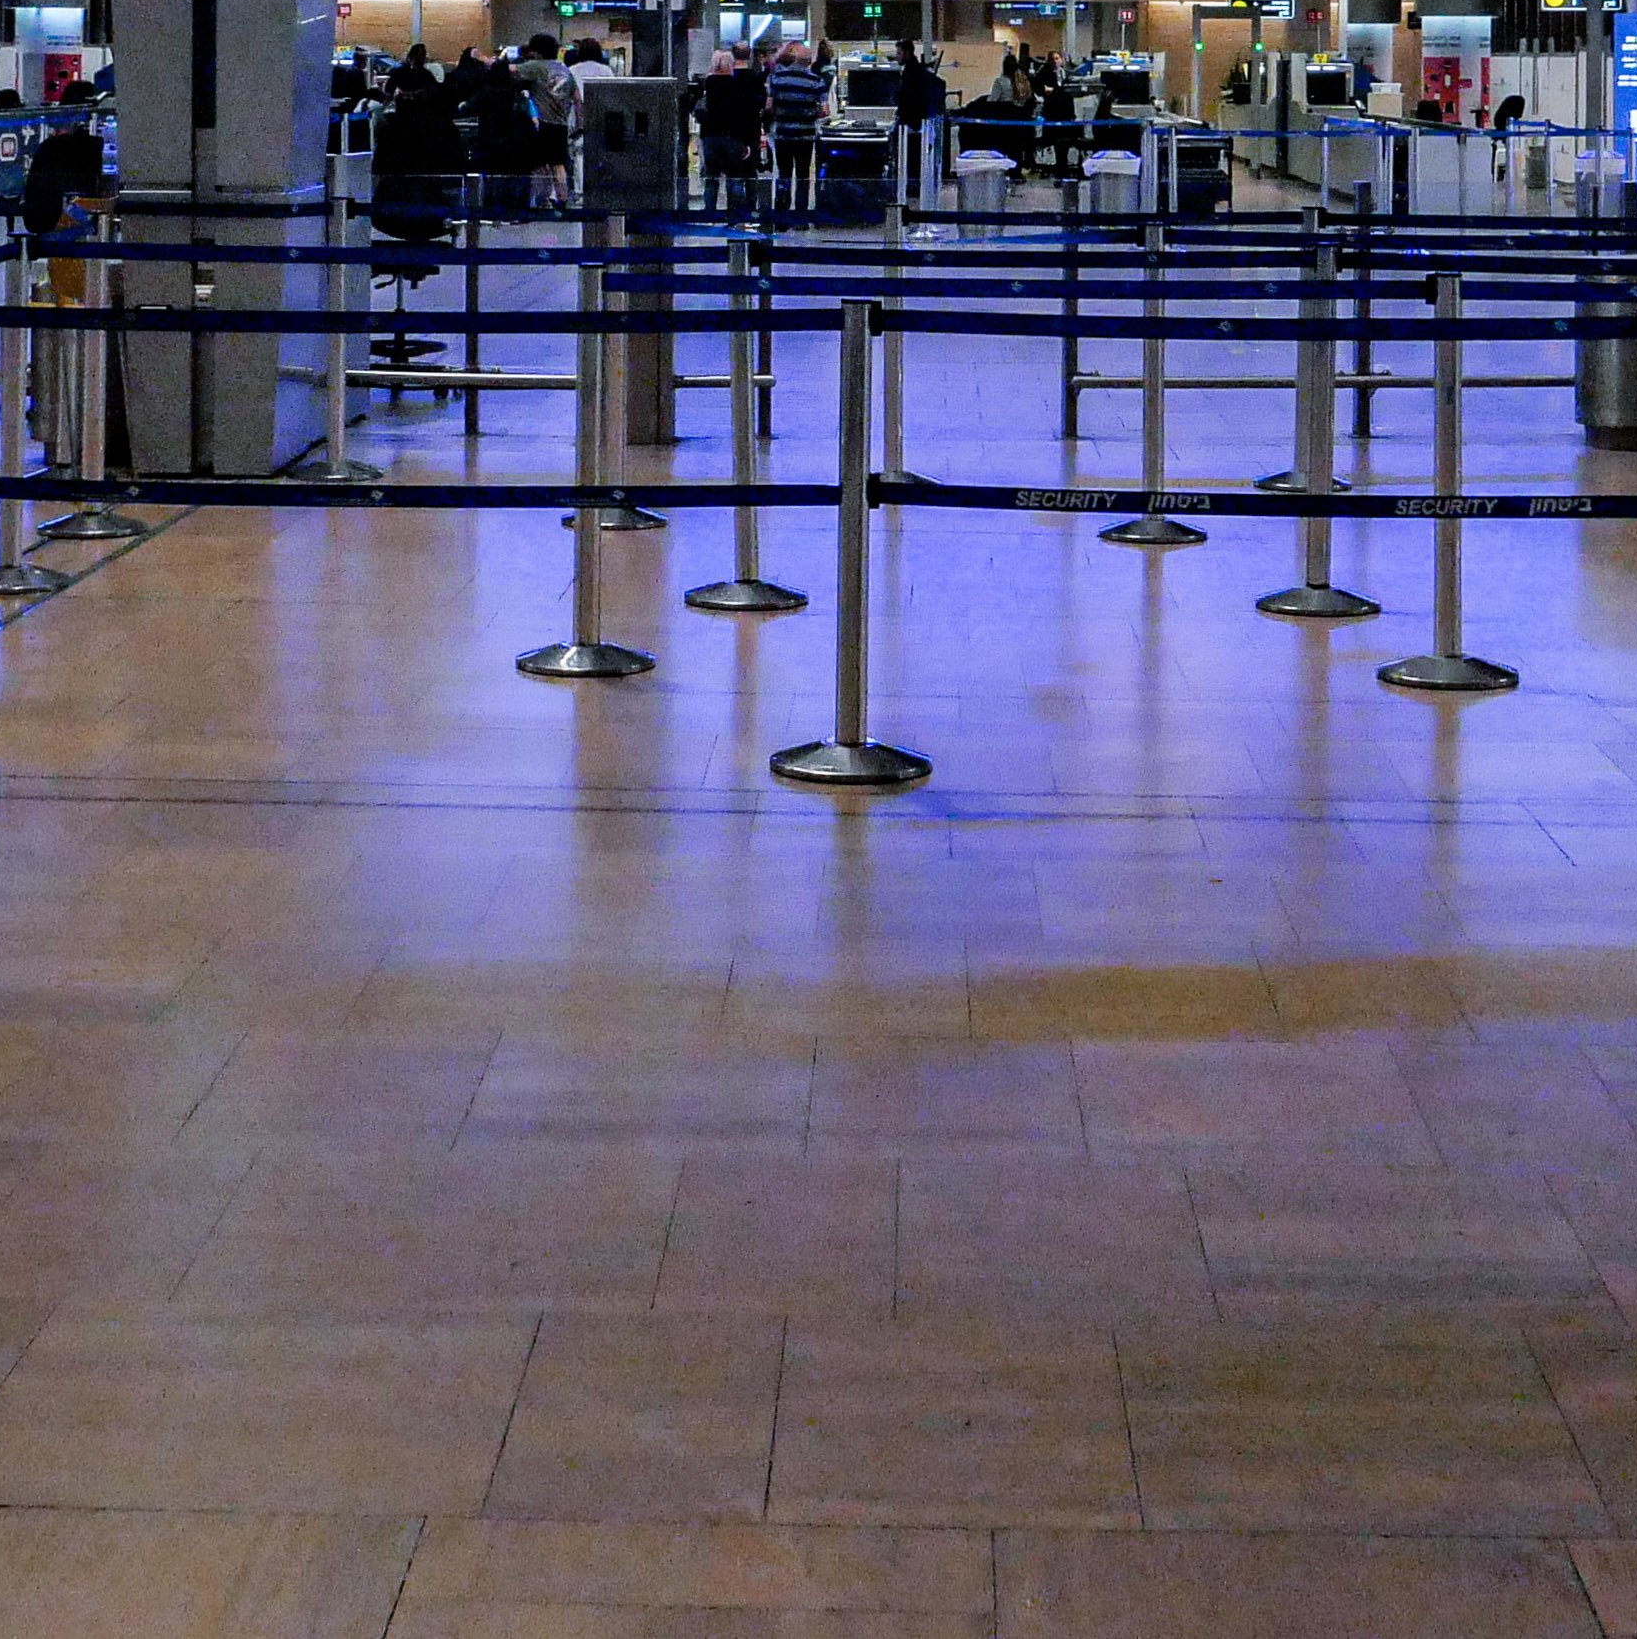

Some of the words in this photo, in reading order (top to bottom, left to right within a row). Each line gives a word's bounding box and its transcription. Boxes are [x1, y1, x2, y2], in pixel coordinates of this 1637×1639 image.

[1015, 490, 1118, 510] SECURITY
[1147, 493, 1211, 513] ביטחון
[1395, 497, 1498, 516] SECURITY
[1529, 497, 1593, 517] ביטחון
